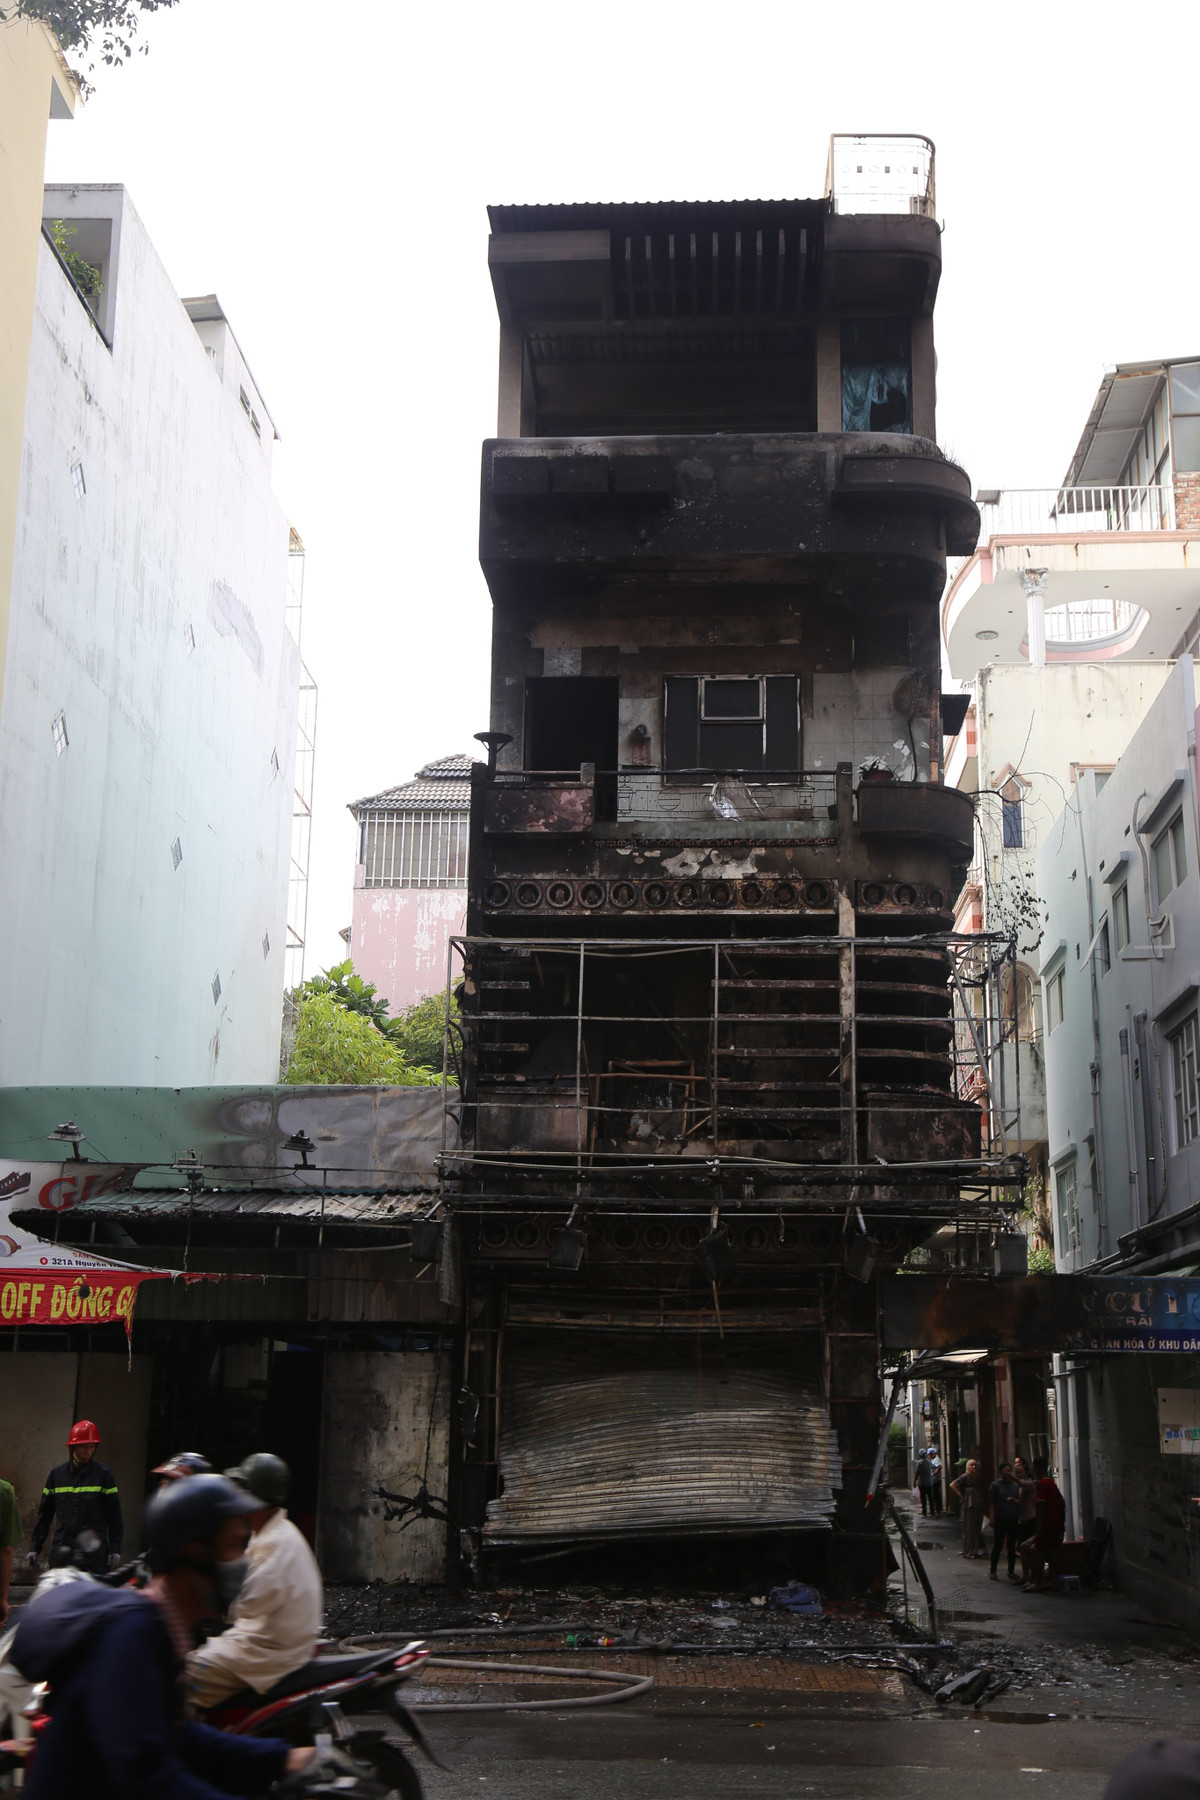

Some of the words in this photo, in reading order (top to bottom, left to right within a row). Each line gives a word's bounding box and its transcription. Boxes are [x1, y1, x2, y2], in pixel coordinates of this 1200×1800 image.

[52, 1258, 74, 1267] 321A
[1, 1281, 45, 1319] OFF
[1124, 1336, 1145, 1349] HÓA
[1148, 1336, 1156, 1349] Ở
[1159, 1340, 1180, 1350] KHU
